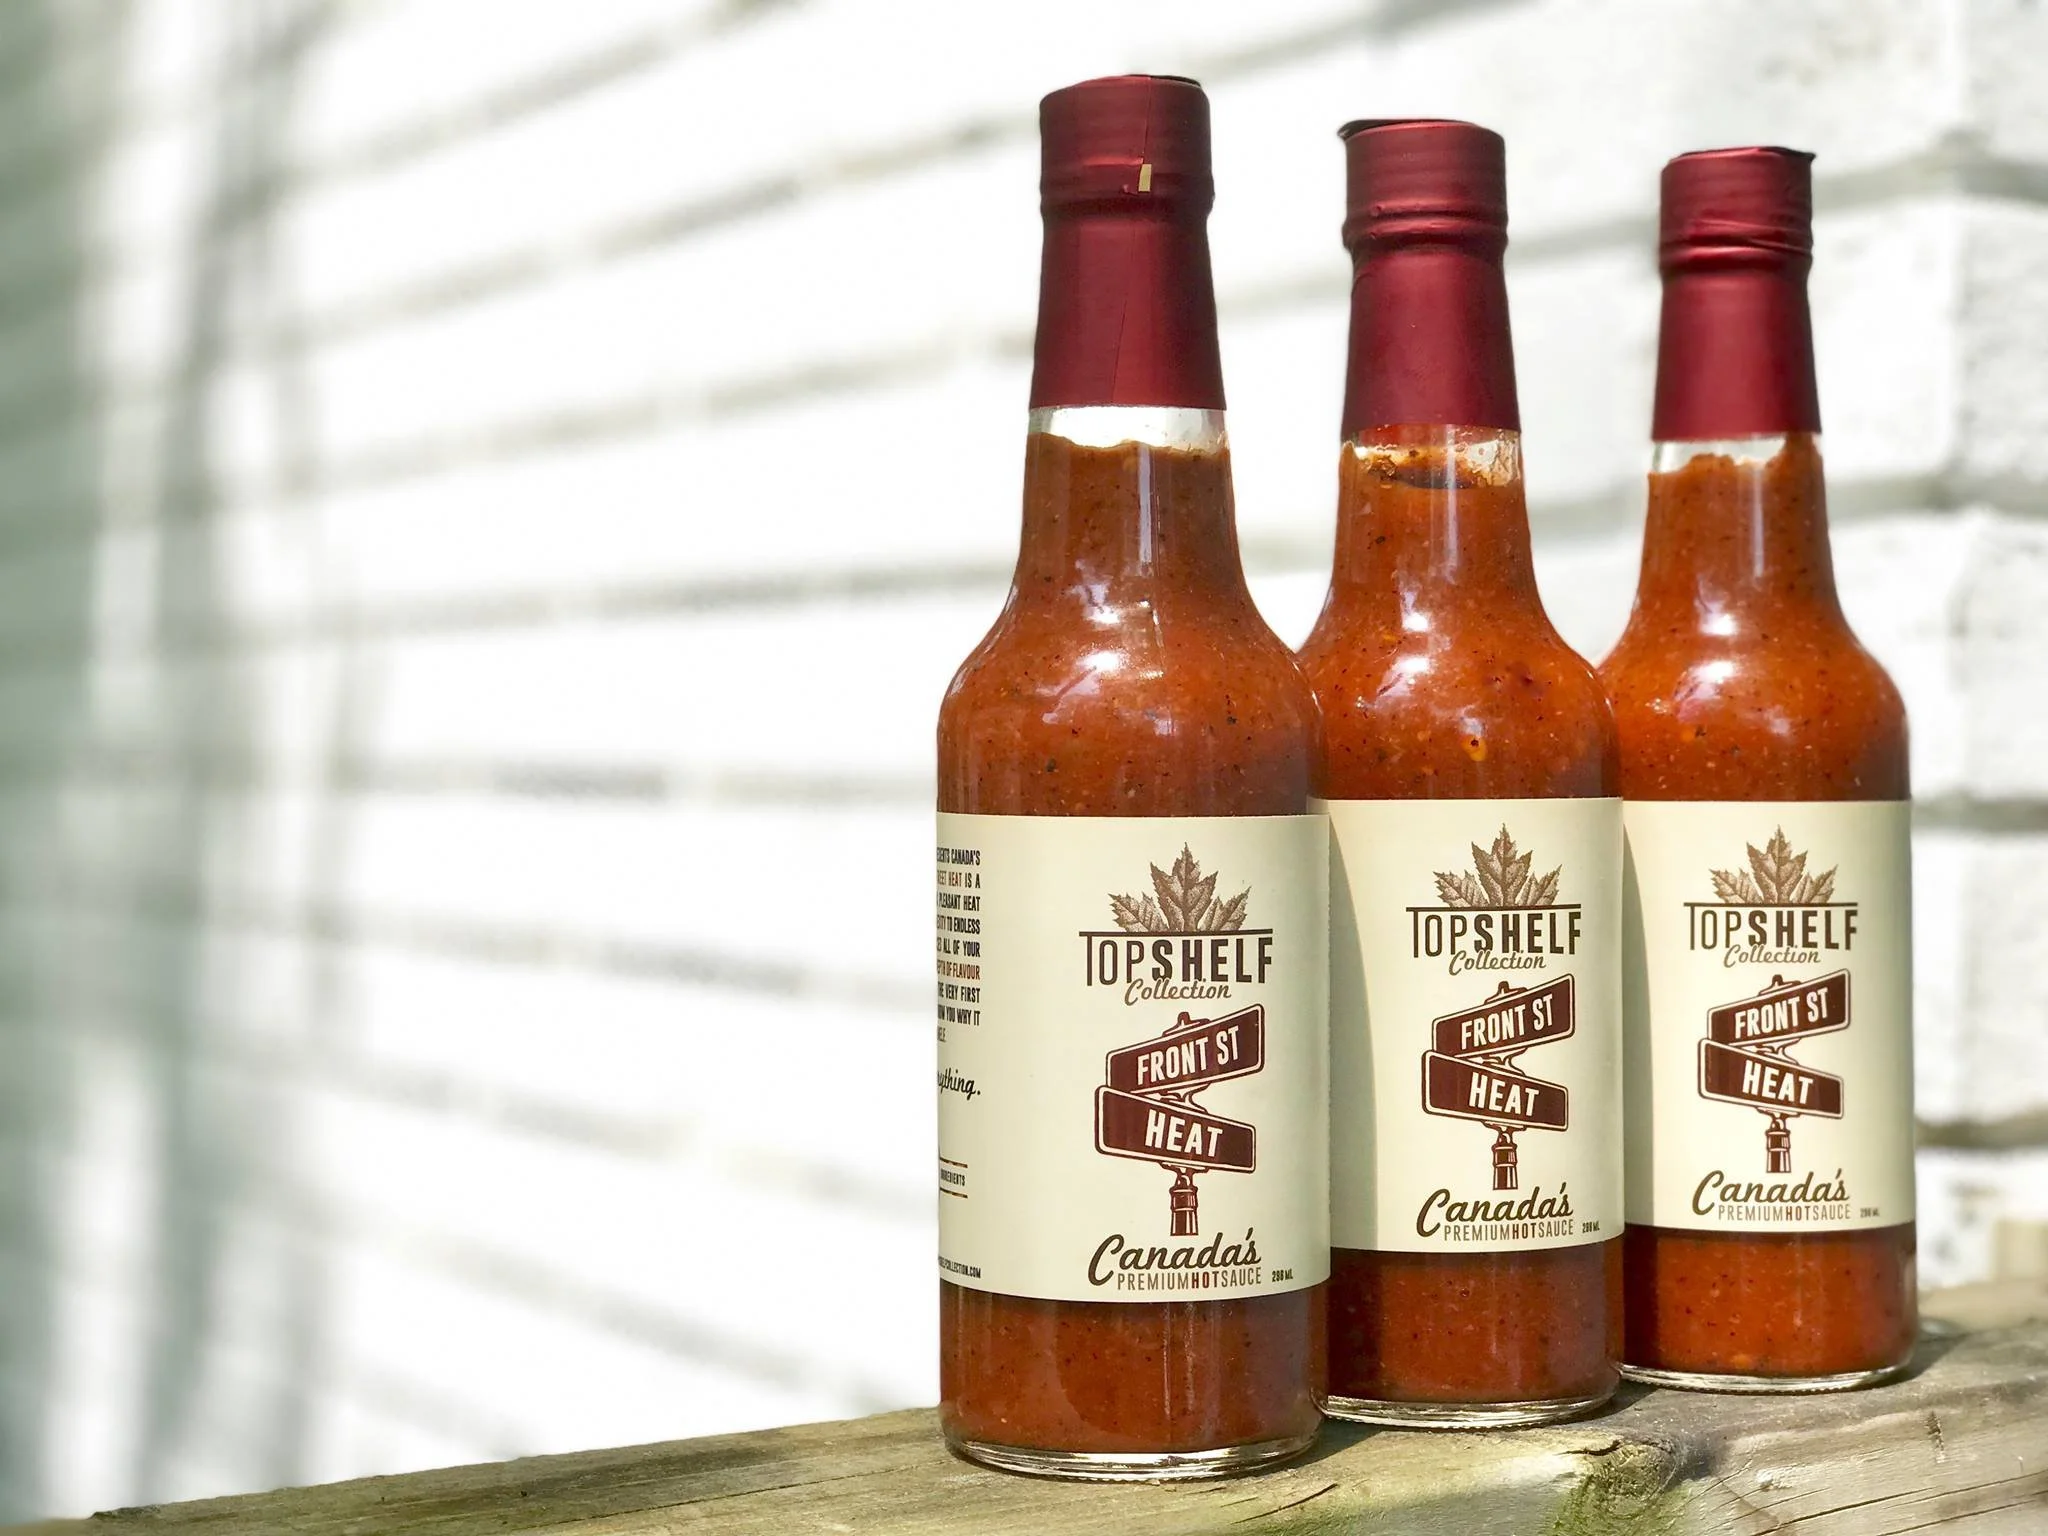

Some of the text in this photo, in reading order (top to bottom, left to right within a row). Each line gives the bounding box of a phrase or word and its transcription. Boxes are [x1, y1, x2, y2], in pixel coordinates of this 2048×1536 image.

[951, 849, 981, 866] CANADA'S
[948, 871, 962, 887] HEAT
[965, 872, 972, 888] IS
[975, 873, 981, 889] A
[963, 895, 980, 912] HEAT
[953, 917, 980, 935] ENDLESS
[1406, 904, 1581, 958] TOPSHELF
[1683, 902, 1858, 951] TOPSHELF
[952, 939, 960, 955] OF
[963, 941, 980, 957] YOUR
[1079, 929, 1273, 986] TOPSHELF
[1723, 944, 1821, 968] Collection
[953, 962, 980, 980] FLAVOUR
[1448, 950, 1547, 976] Collection
[945, 983, 959, 1001] VERY
[960, 986, 980, 1004] FIRST
[1124, 977, 1232, 1006] Collection
[957, 1008, 972, 1026] WHY
[973, 1010, 980, 1027] IT
[1461, 993, 1553, 1050] FRONT ST
[1735, 987, 1828, 1039] FRONT ST
[1137, 1025, 1239, 1086] FRONT ST
[1468, 1071, 1540, 1117] HEAT
[1742, 1059, 1814, 1105] HEAT
[1144, 1108, 1223, 1158] HEAT
[1692, 1168, 1850, 1216] Canada's
[1416, 1182, 1574, 1238] Canada's
[1444, 1219, 1574, 1242] PREMIUMHOTSAUCE
[1088, 1227, 1262, 1286] Canada's
[1117, 1266, 1262, 1290] PREMIUMHOTSAUCE
